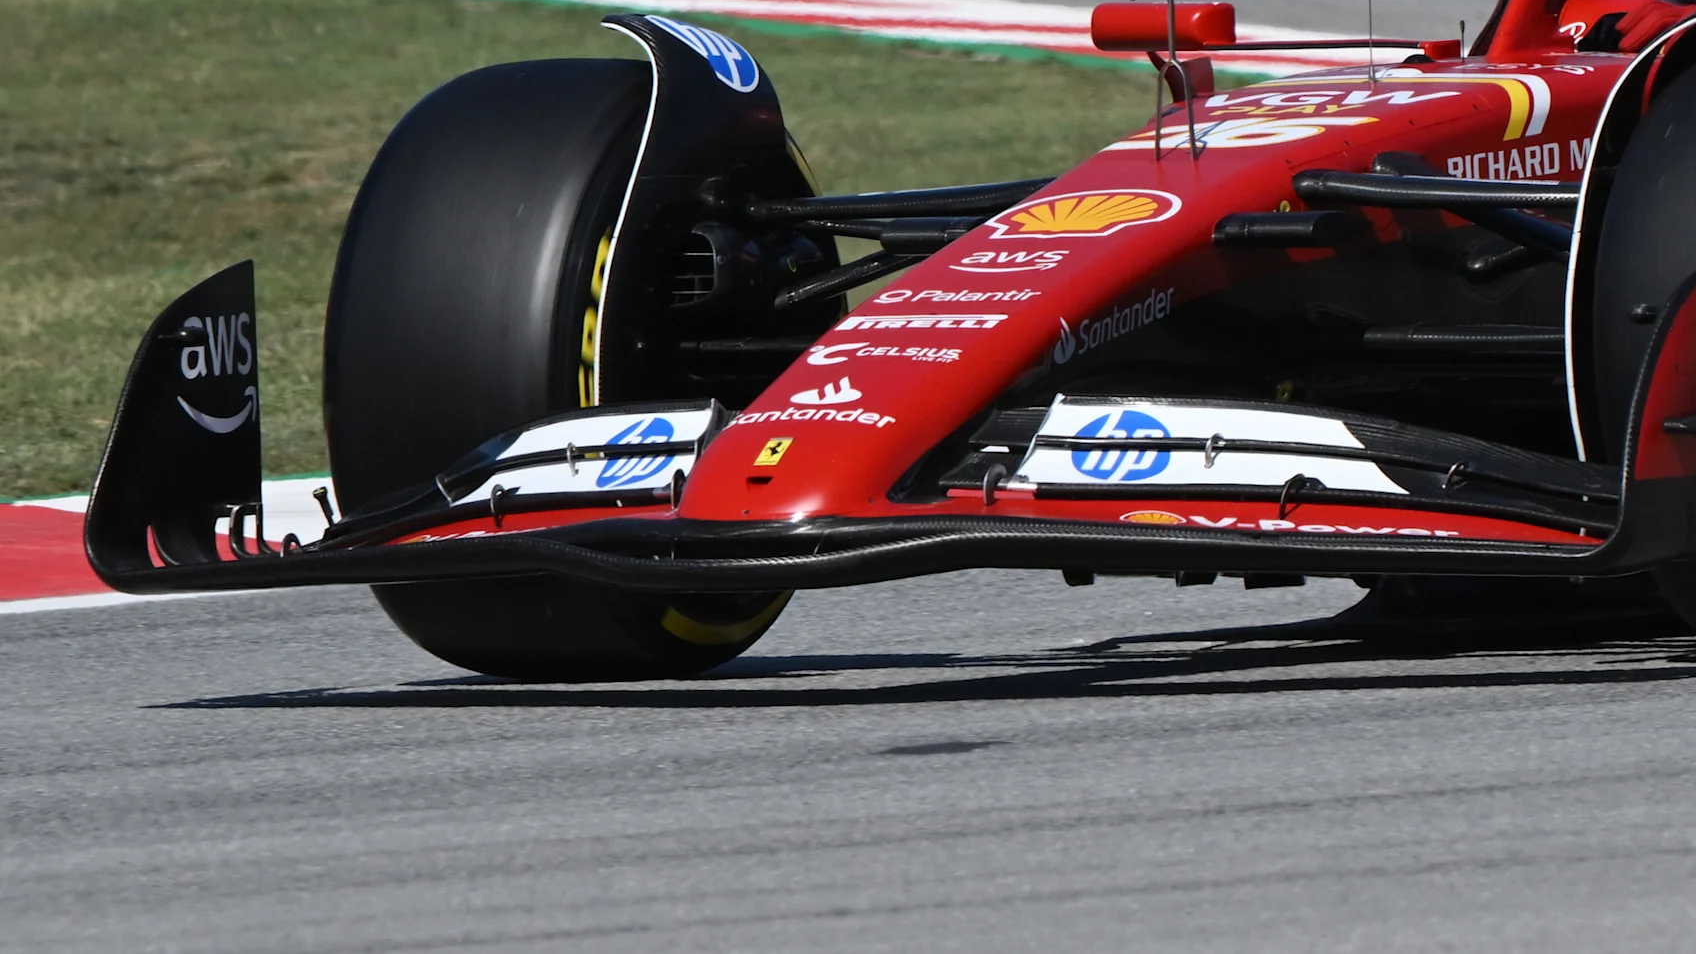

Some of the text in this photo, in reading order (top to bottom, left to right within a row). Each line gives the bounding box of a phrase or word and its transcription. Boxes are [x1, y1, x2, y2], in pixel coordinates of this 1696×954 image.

[1205, 90, 1462, 107] VGW
[1209, 104, 1367, 116] PLAY
[1098, 116, 1381, 153] 16
[1447, 142, 1561, 182] RICHARD
[960, 250, 1070, 264] aws
[910, 289, 1042, 303] Palantir
[834, 314, 1009, 331] PIRELLI
[1078, 287, 1175, 355] Santander
[180, 311, 254, 380] aws
[856, 347, 963, 359] CELSIUS
[722, 406, 897, 429] Santander
[598, 416, 673, 488] hp
[1078, 410, 1168, 481] hp
[1189, 515, 1460, 537] V-Power
